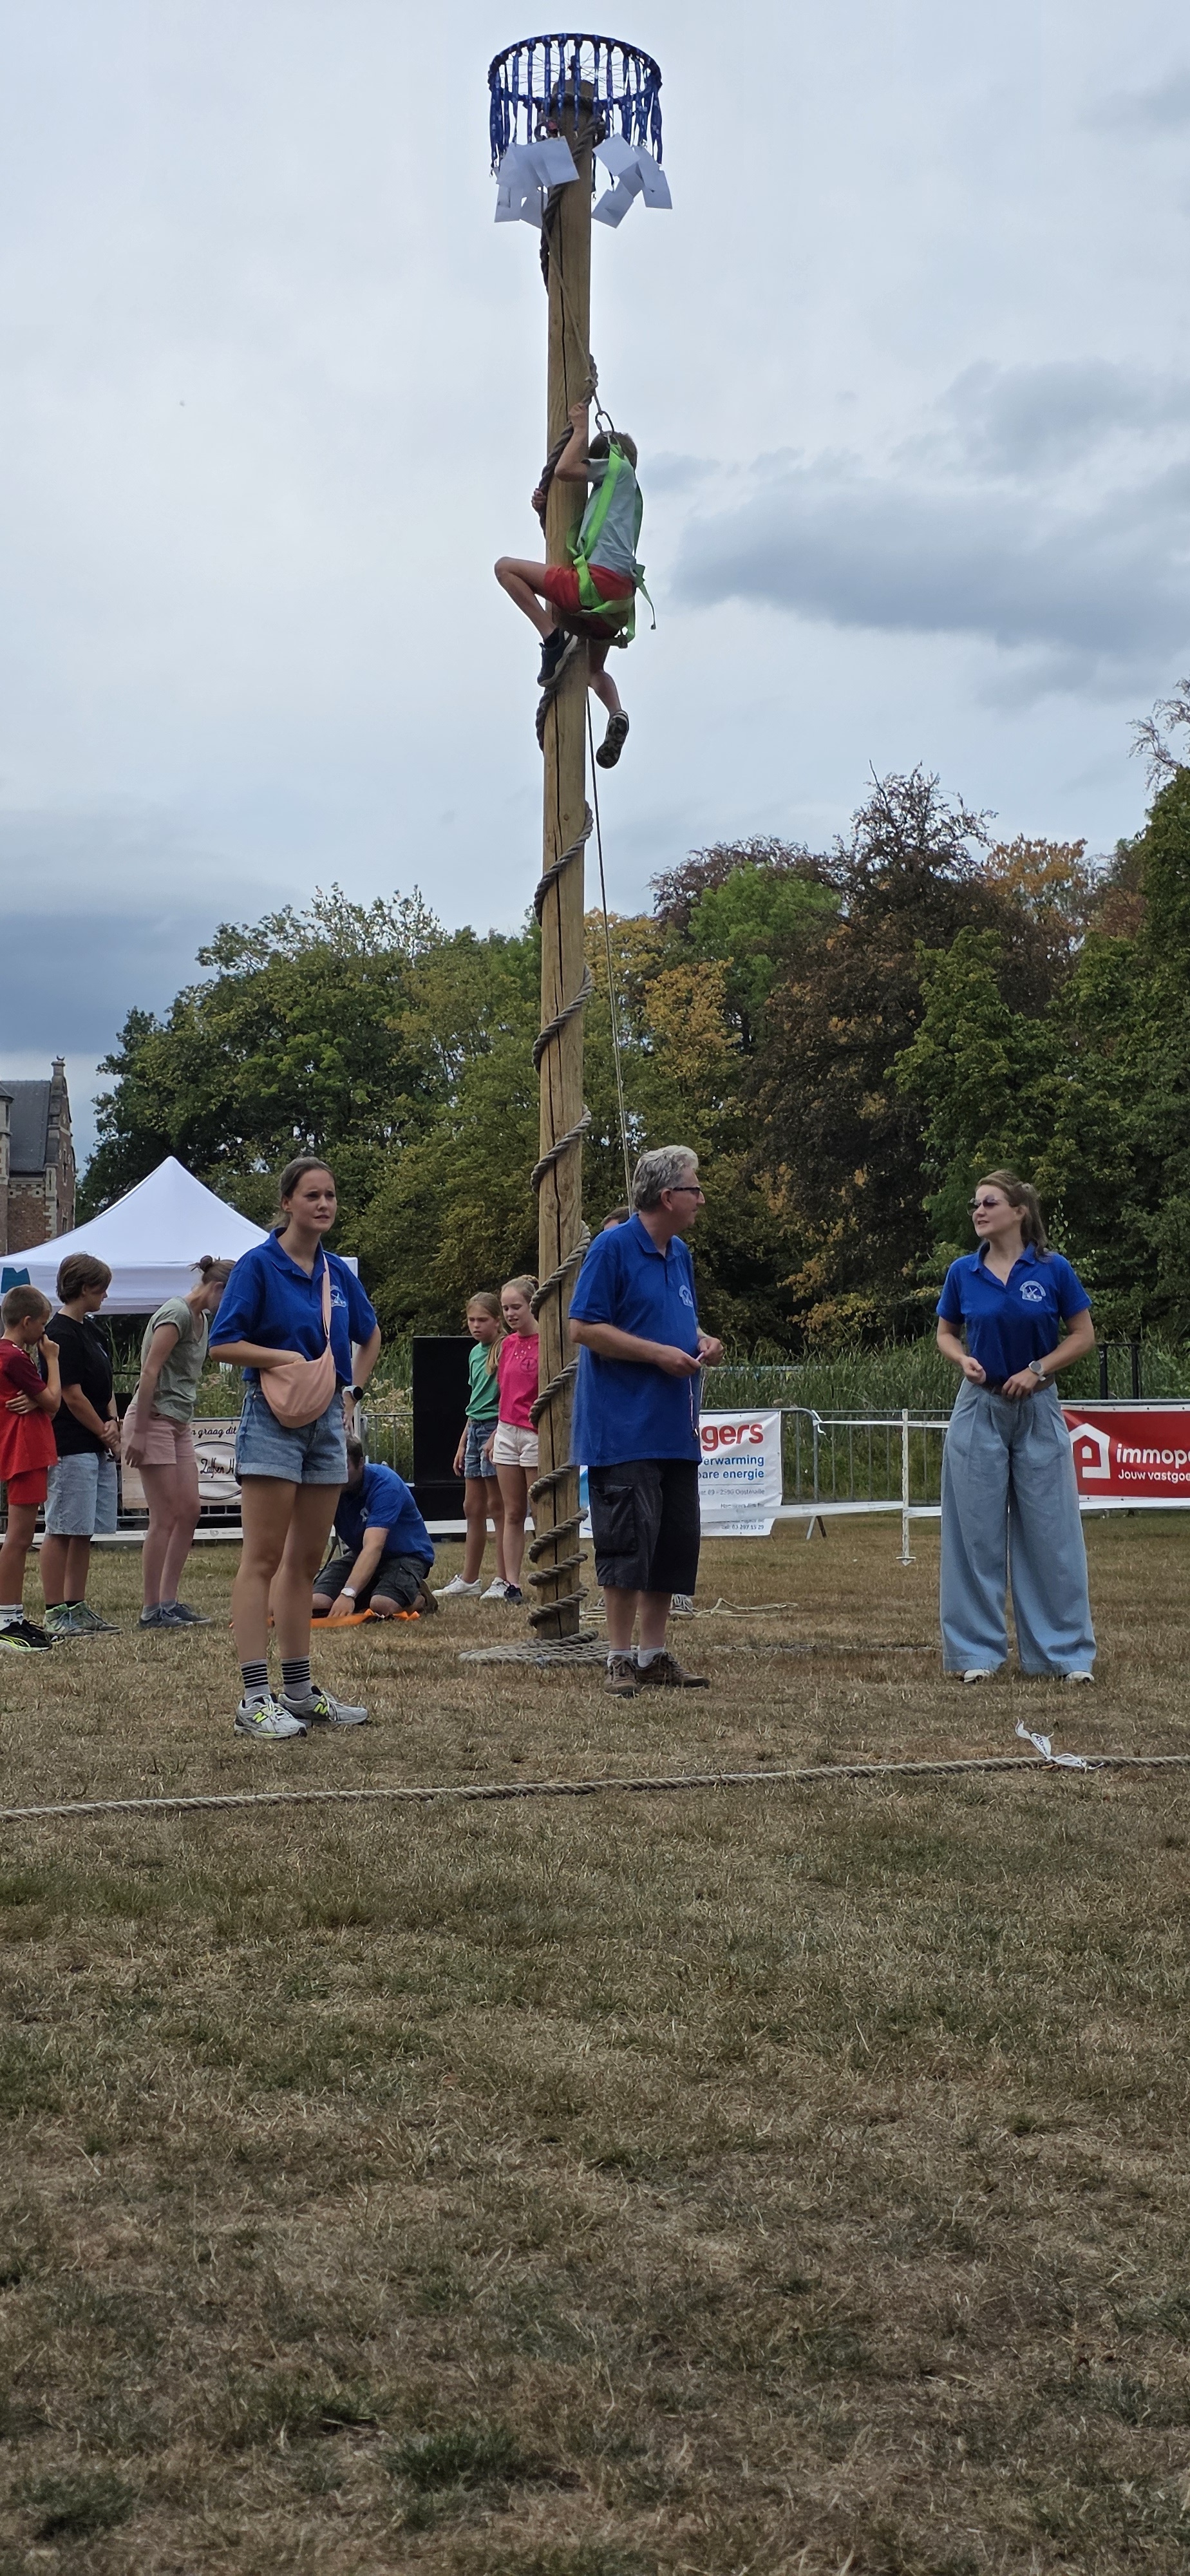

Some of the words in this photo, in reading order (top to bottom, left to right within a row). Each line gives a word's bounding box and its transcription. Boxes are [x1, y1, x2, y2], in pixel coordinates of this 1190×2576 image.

[701, 1454, 764, 1467] erwarming
[1117, 1443, 1190, 1469] immop
[722, 1468, 764, 1481] energie
[1118, 1469, 1146, 1480] Jouw
